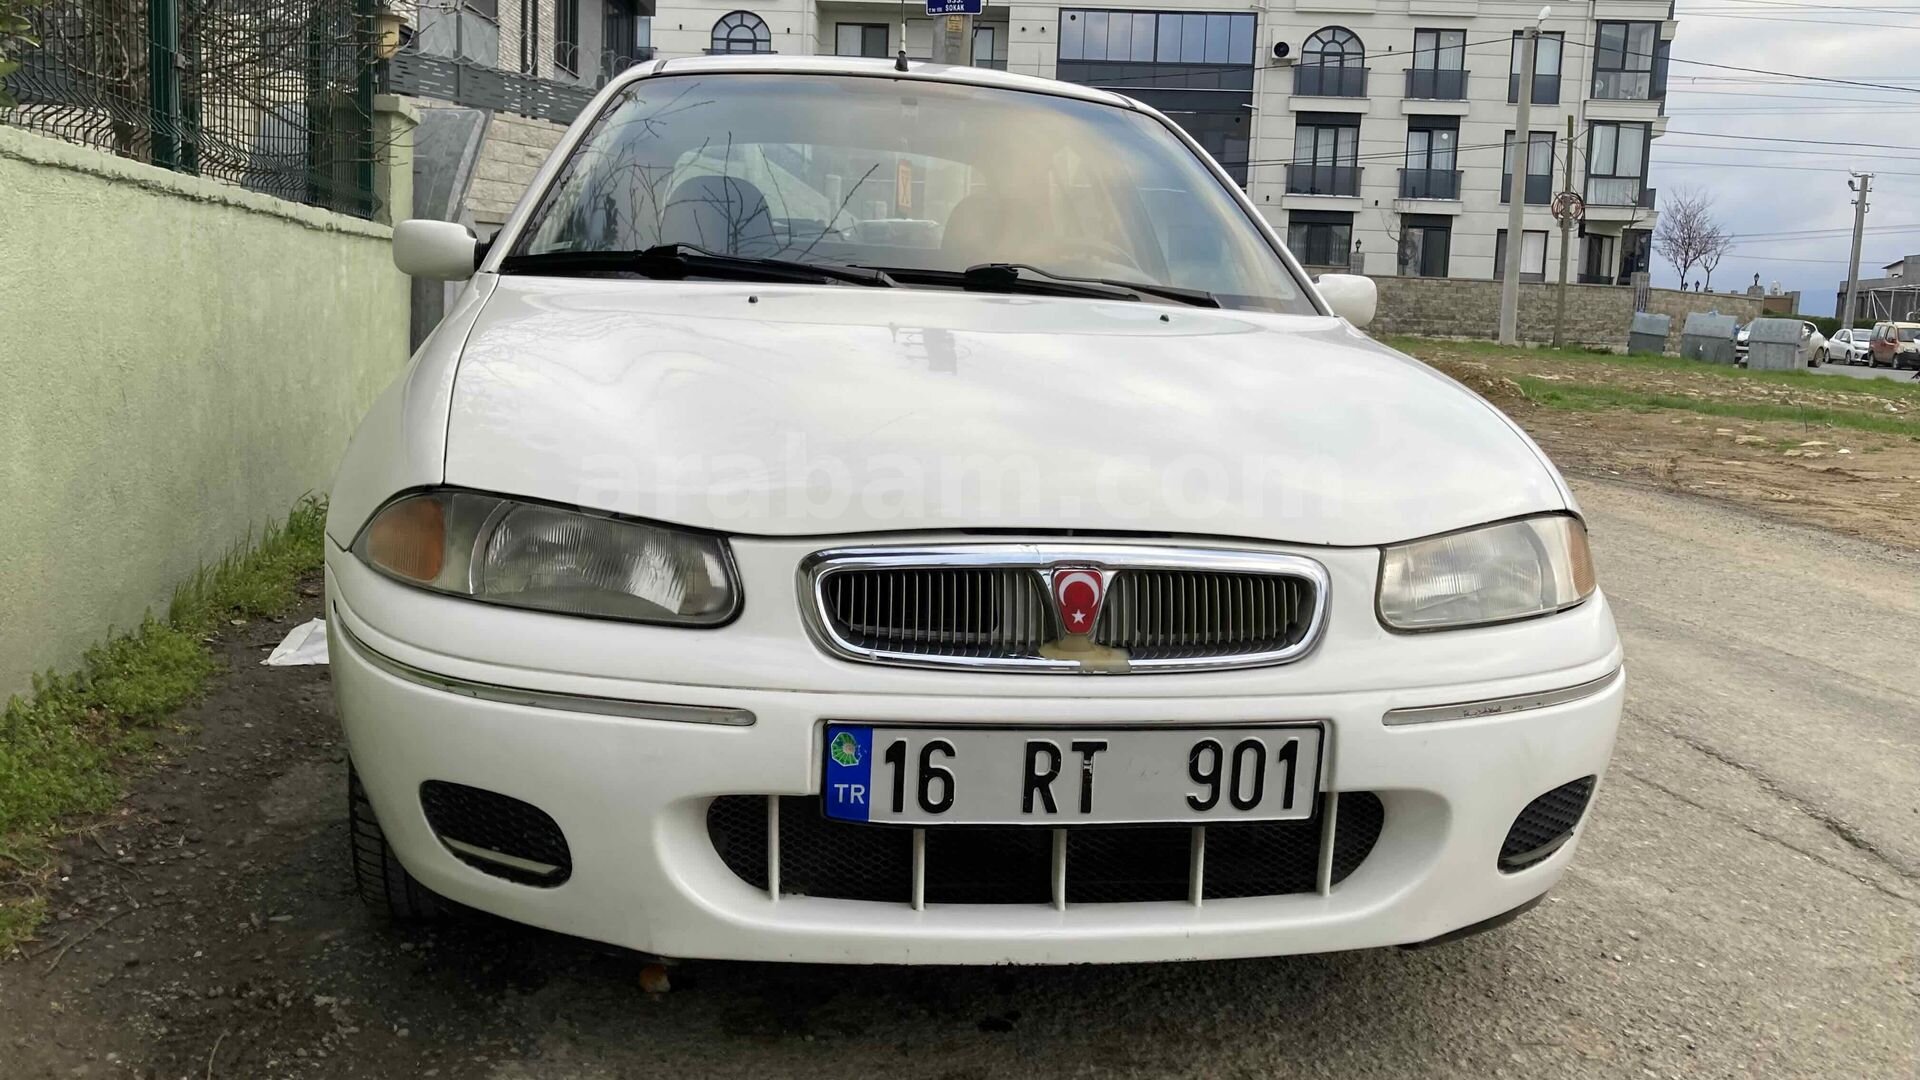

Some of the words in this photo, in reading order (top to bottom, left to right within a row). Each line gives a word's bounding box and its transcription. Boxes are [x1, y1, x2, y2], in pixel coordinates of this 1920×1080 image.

[945, 4, 965, 12] SOKAK
[885, 739, 956, 814] 16
[1022, 740, 1108, 814] RT
[1186, 738, 1299, 812] 901
[833, 783, 866, 805] TR
